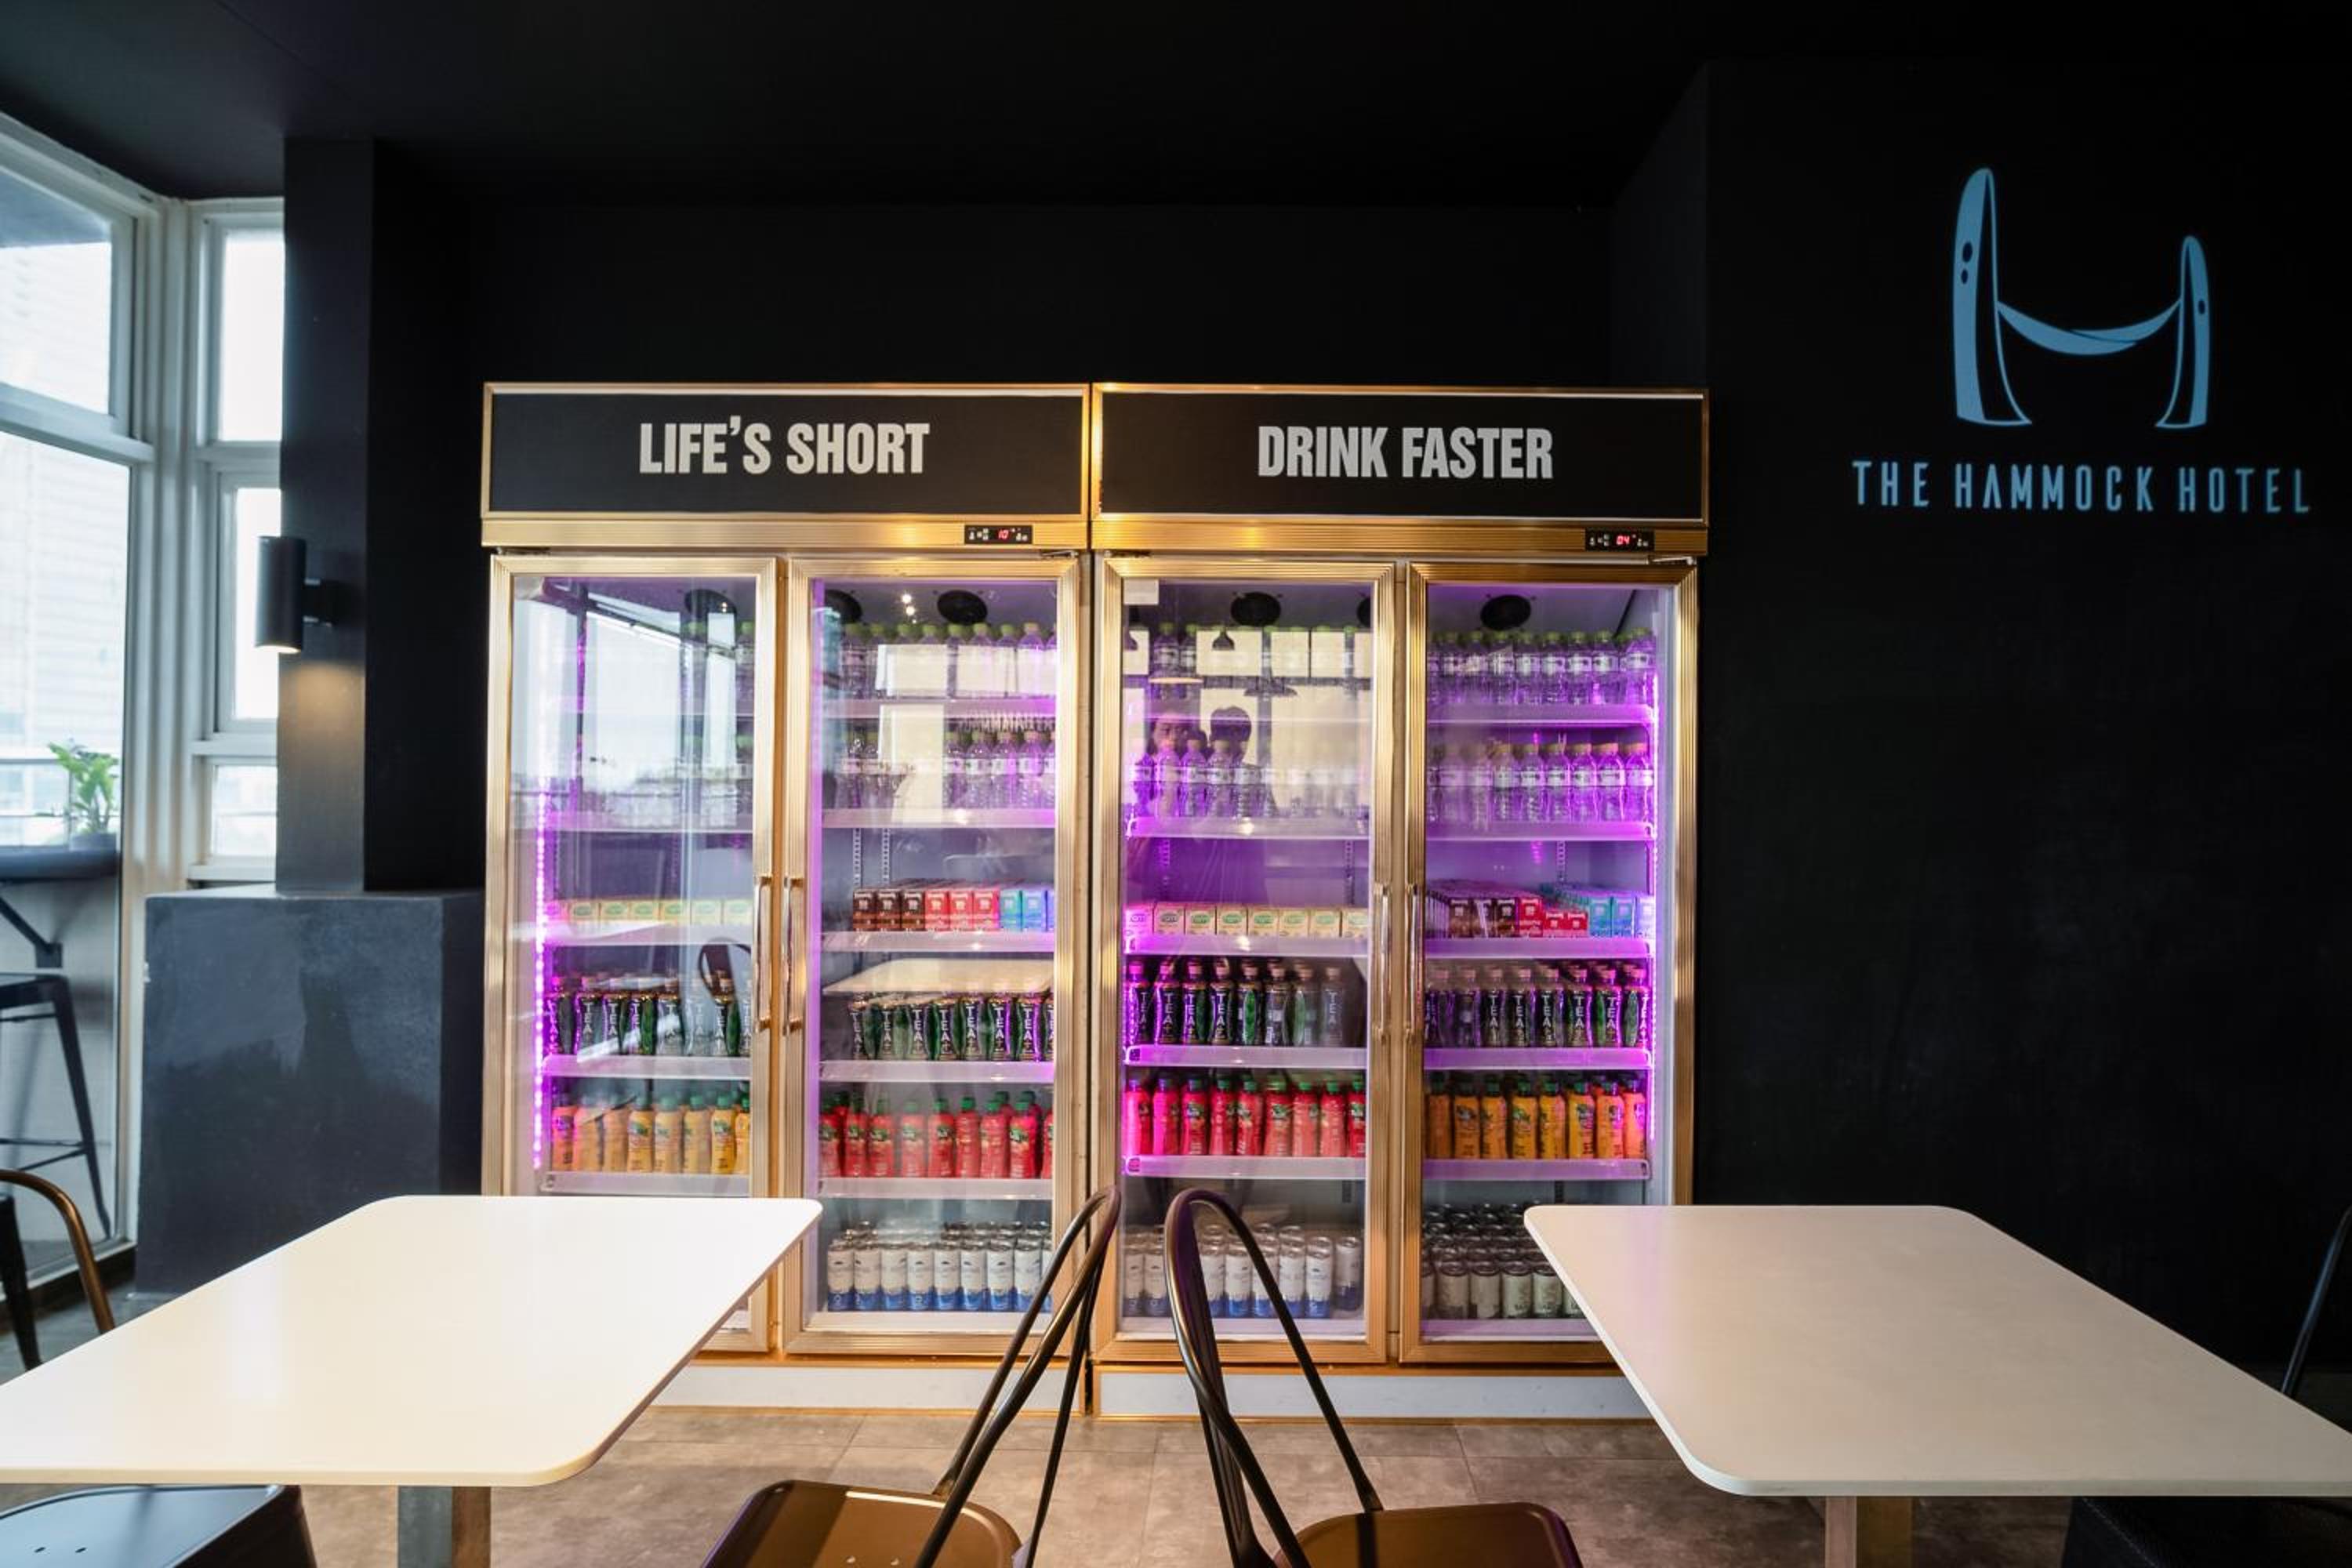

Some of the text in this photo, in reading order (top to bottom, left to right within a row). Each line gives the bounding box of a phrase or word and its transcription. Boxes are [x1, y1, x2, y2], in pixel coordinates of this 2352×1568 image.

[639, 416, 931, 475] LIFE'S SHORT
[1258, 426, 1554, 480] DRINK FASTER
[1852, 459, 2311, 514] THE HAMMOCK HOTEL
